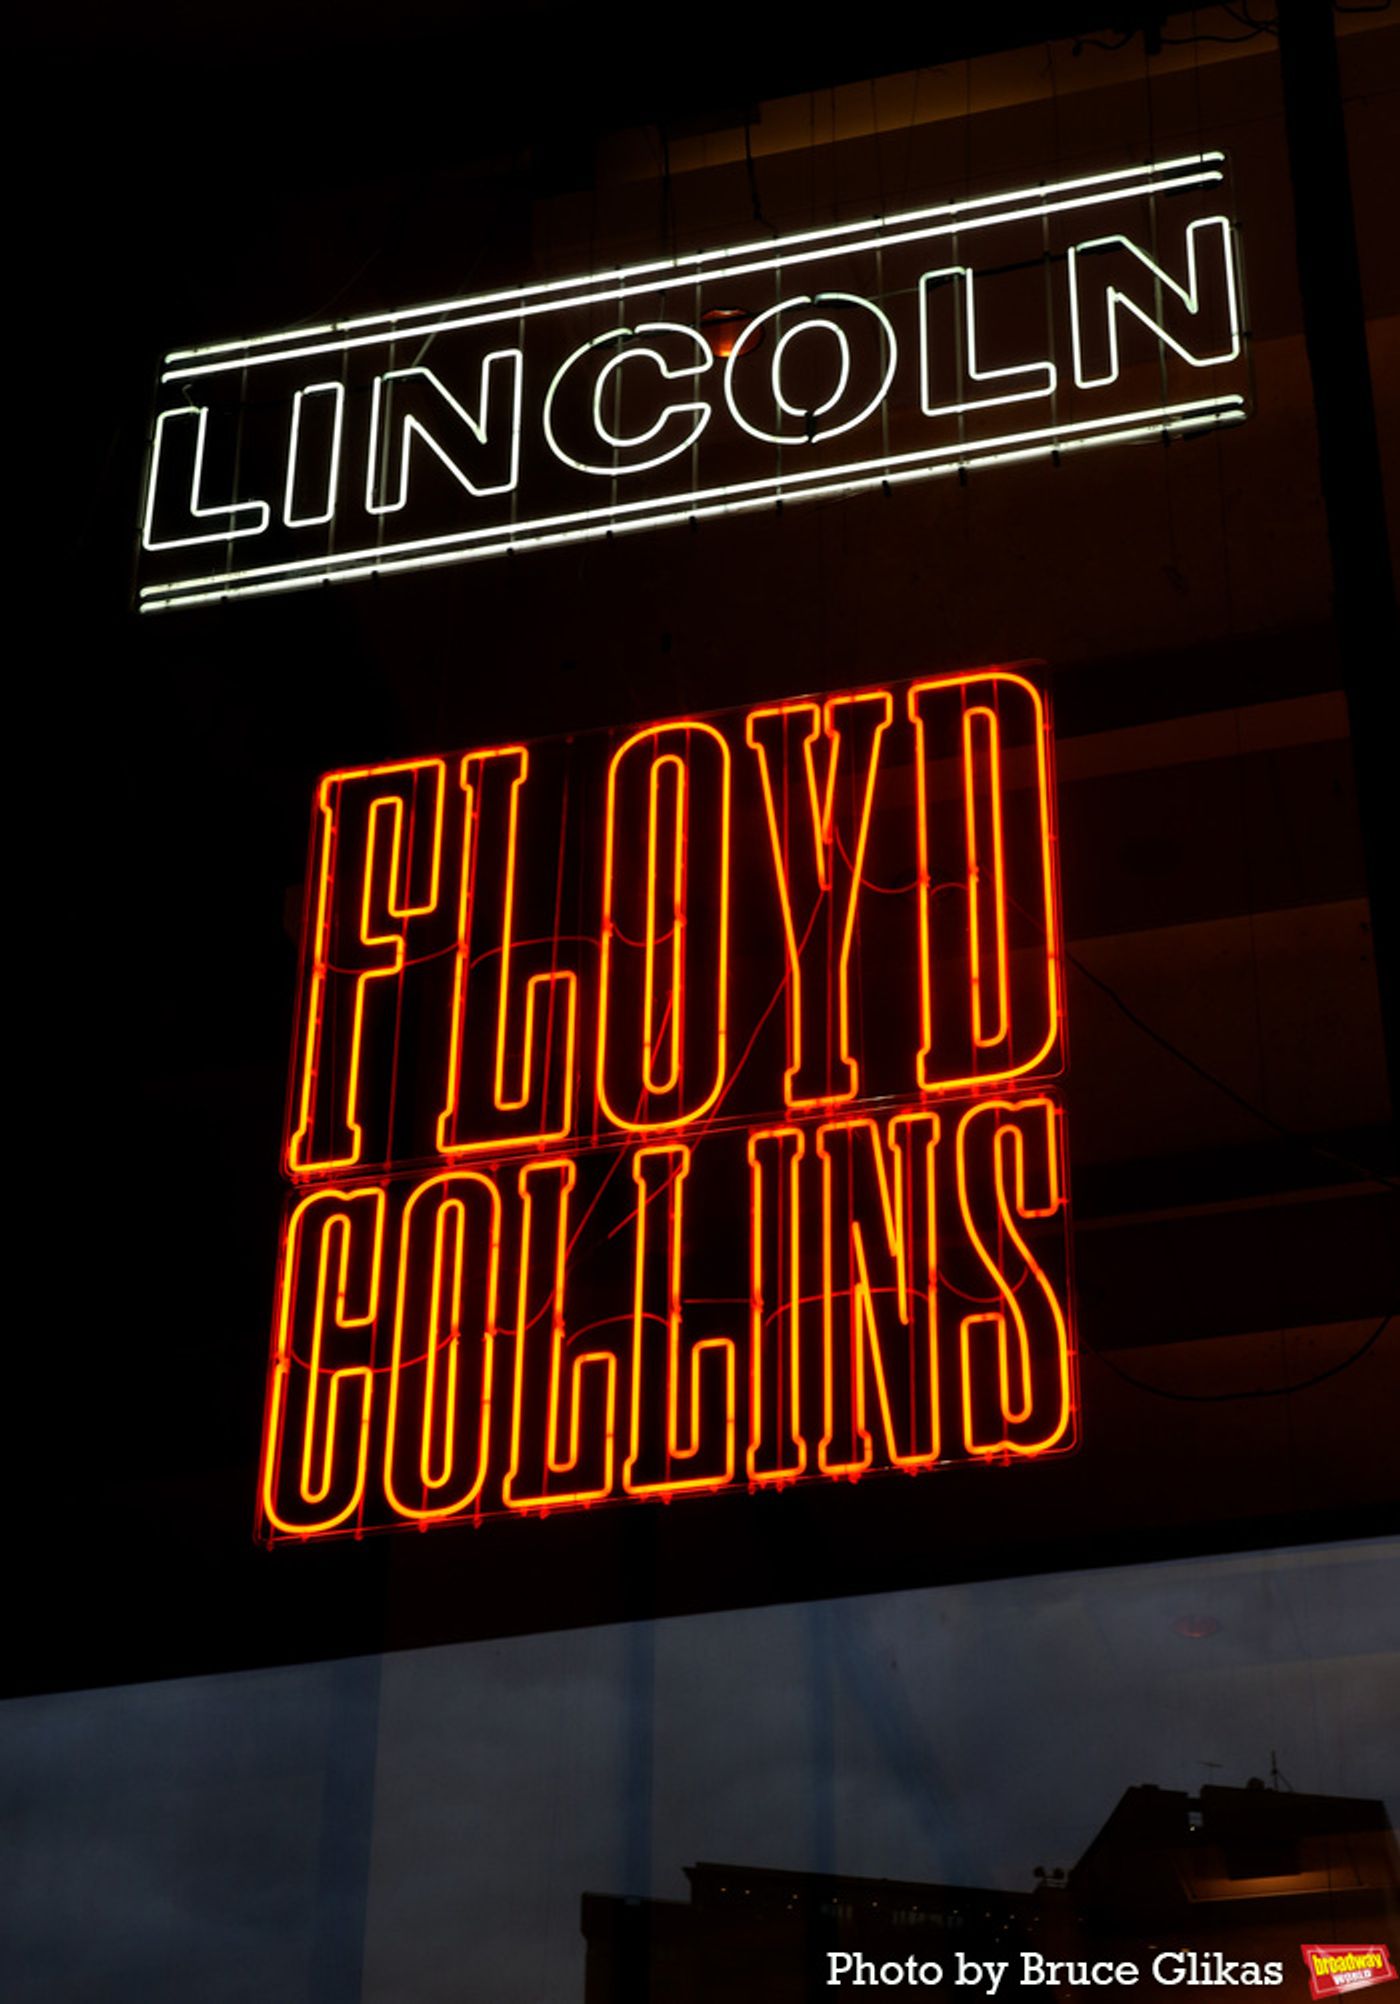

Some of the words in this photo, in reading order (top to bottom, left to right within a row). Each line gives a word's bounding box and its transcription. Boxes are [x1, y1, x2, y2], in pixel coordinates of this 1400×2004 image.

[141, 214, 1243, 553] LINCOLN
[287, 669, 1062, 1175] FLOYD
[259, 1096, 1075, 1538] COLLINS
